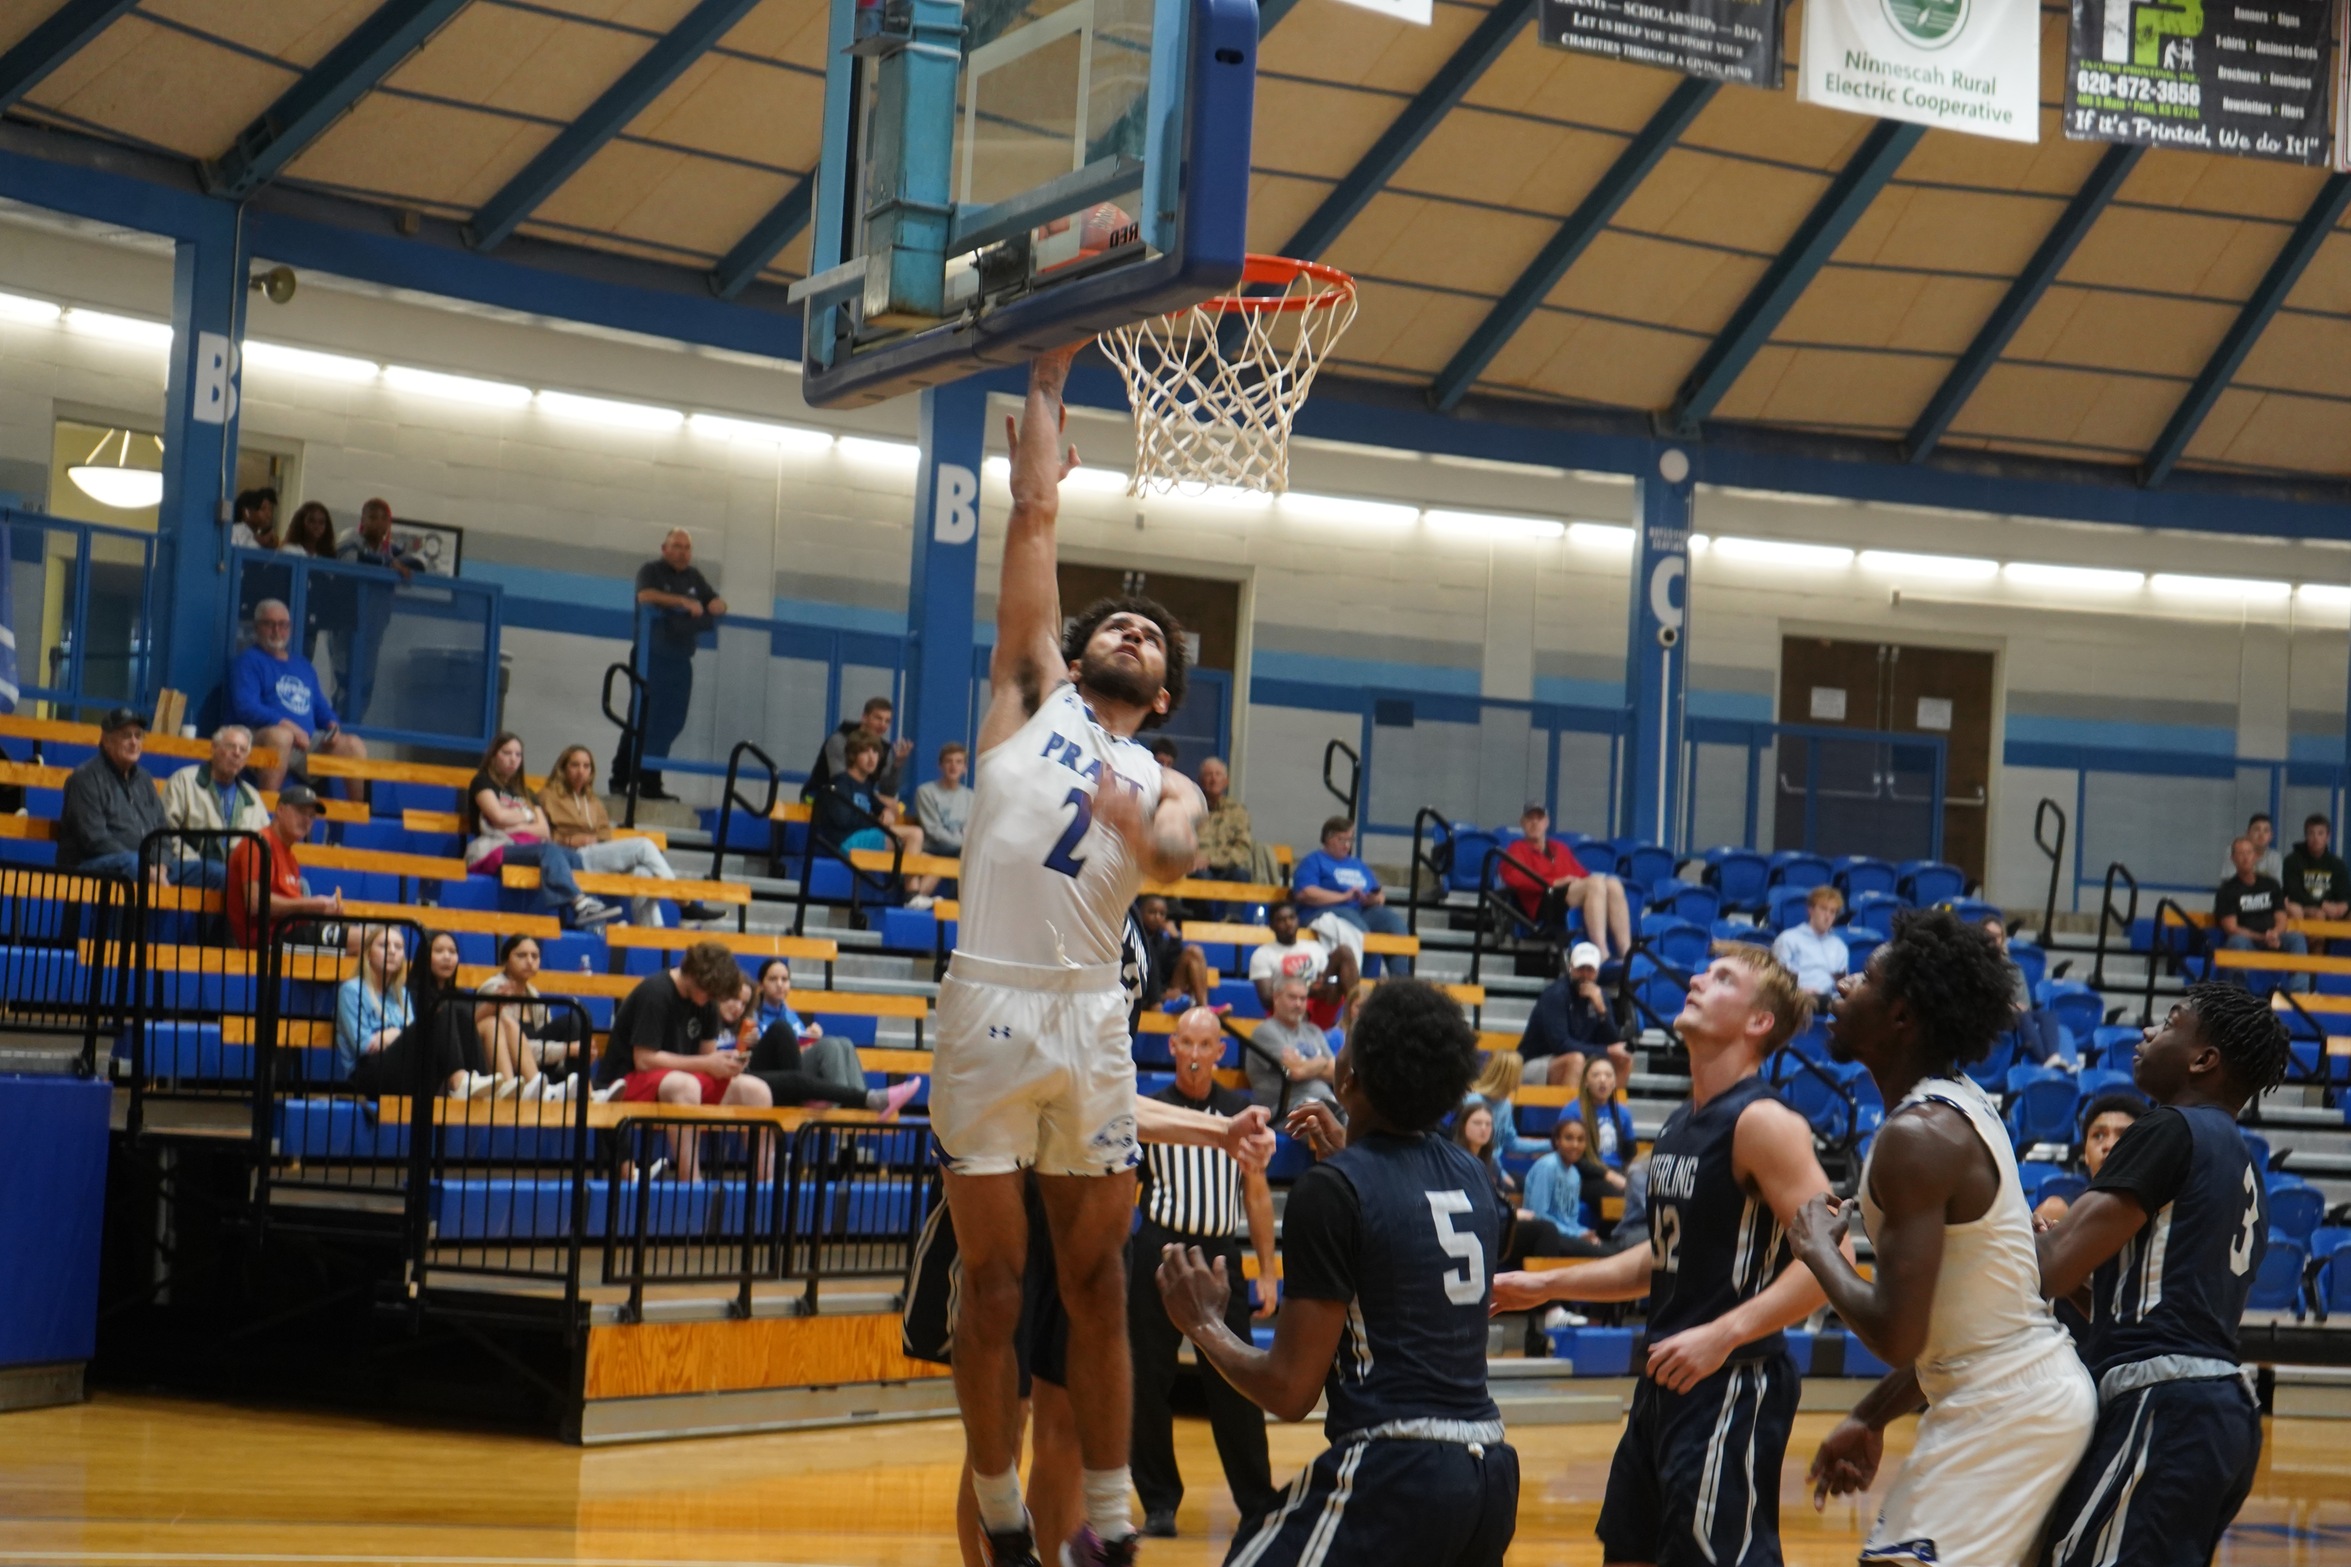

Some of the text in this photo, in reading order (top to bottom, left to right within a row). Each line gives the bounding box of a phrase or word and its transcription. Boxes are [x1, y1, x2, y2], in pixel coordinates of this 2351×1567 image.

[1598, 17, 1613, 32] US
[1614, 21, 1642, 37] HELP
[1643, 27, 1666, 42] YOU
[1668, 32, 1713, 52] SUPPORT
[1716, 41, 1744, 59] YOUR
[2234, 6, 2300, 28] Banners Signs
[1561, 32, 1753, 80] CHARITIES THROUGH A GIVING FUND
[2216, 34, 2318, 61] T-shirts Business Cards
[1845, 50, 1996, 96] Ninnescah Rural
[2217, 65, 2312, 90] Brochures Envelopes
[1825, 73, 2013, 124] Electric Cooperative
[2103, 96, 2126, 111] Main
[2223, 96, 2304, 119] Newsletters Fliers
[2099, 114, 2128, 136] it's
[2131, 116, 2212, 148] Printed,
[2218, 127, 2250, 150] We
[2256, 131, 2282, 153] do
[193, 331, 239, 424] B
[934, 462, 977, 544] B
[1650, 555, 1685, 626] C
[1043, 787, 1092, 879] 2
[2229, 1161, 2259, 1277] 3
[1424, 1189, 1485, 1305] 5
